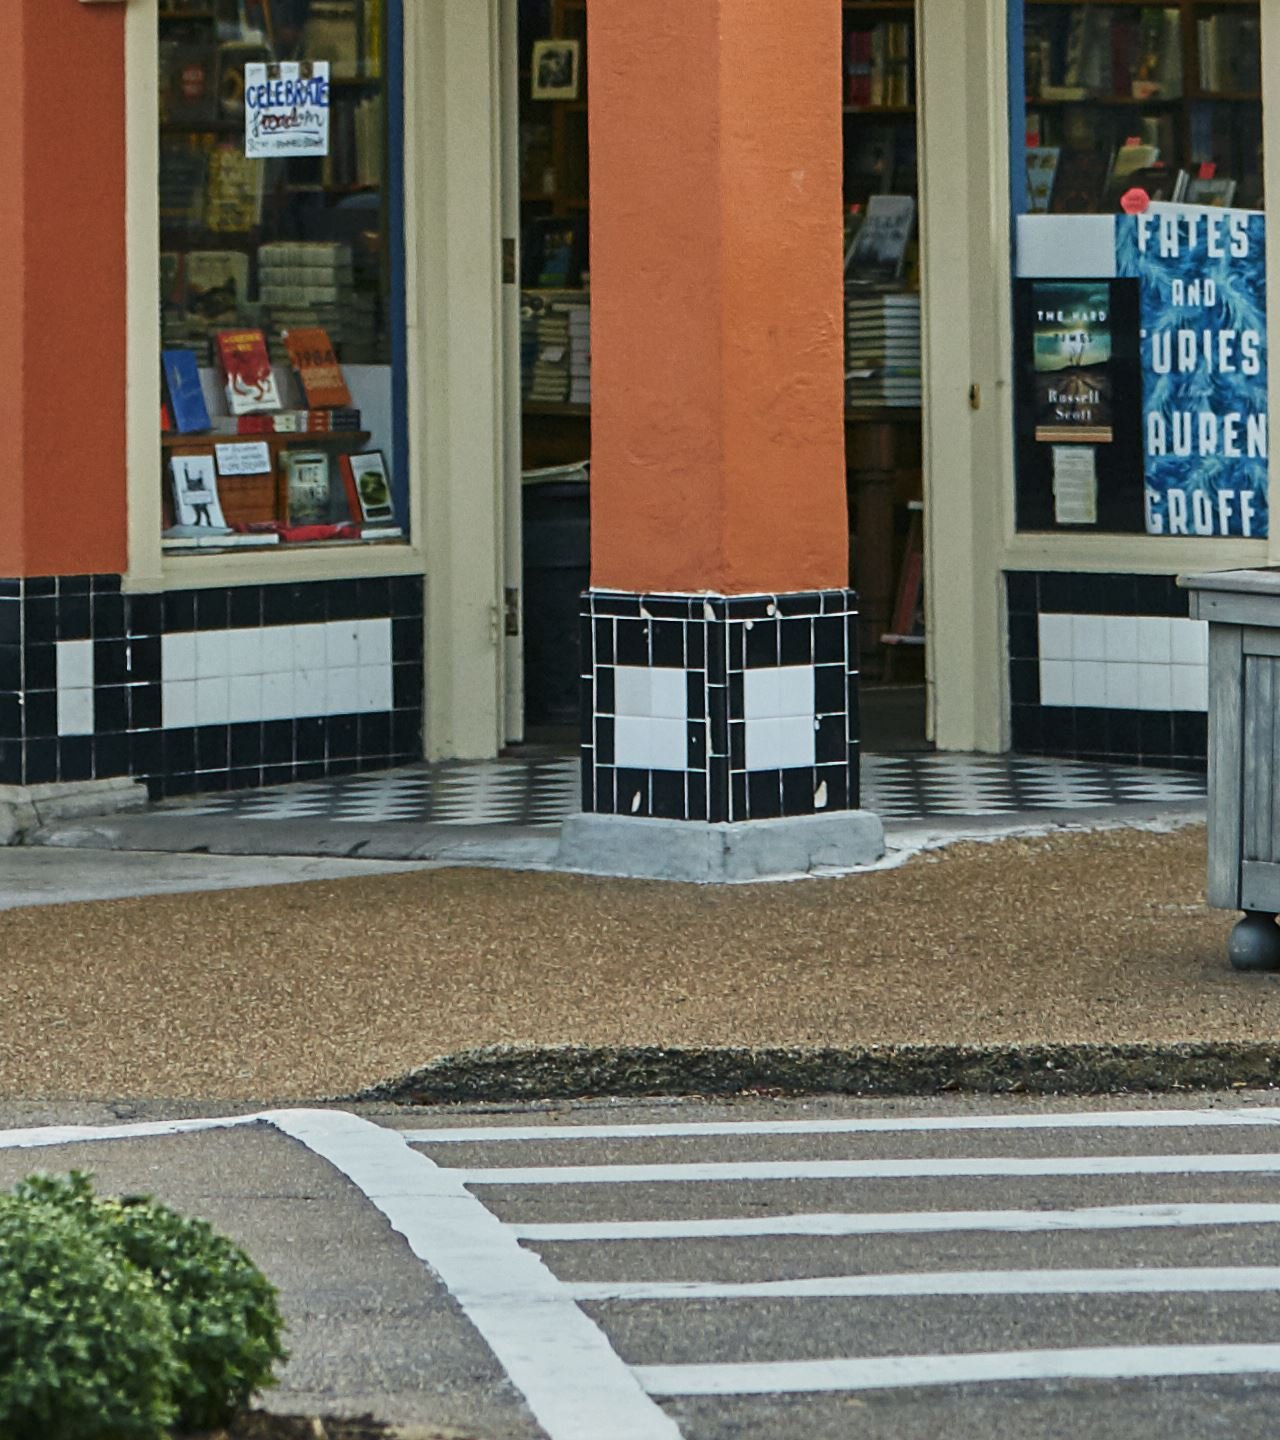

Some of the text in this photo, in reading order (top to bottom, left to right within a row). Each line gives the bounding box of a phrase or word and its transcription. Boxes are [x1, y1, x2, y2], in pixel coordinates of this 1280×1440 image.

[246, 76, 330, 109] CELEBRATE
[1136, 213, 1249, 258] FATES
[1171, 278, 1216, 307] AND
[1036, 310, 1064, 323] THE
[1140, 329, 1261, 376] URIES
[1147, 411, 1267, 459] AUREN
[1144, 488, 1256, 538] GROFF
